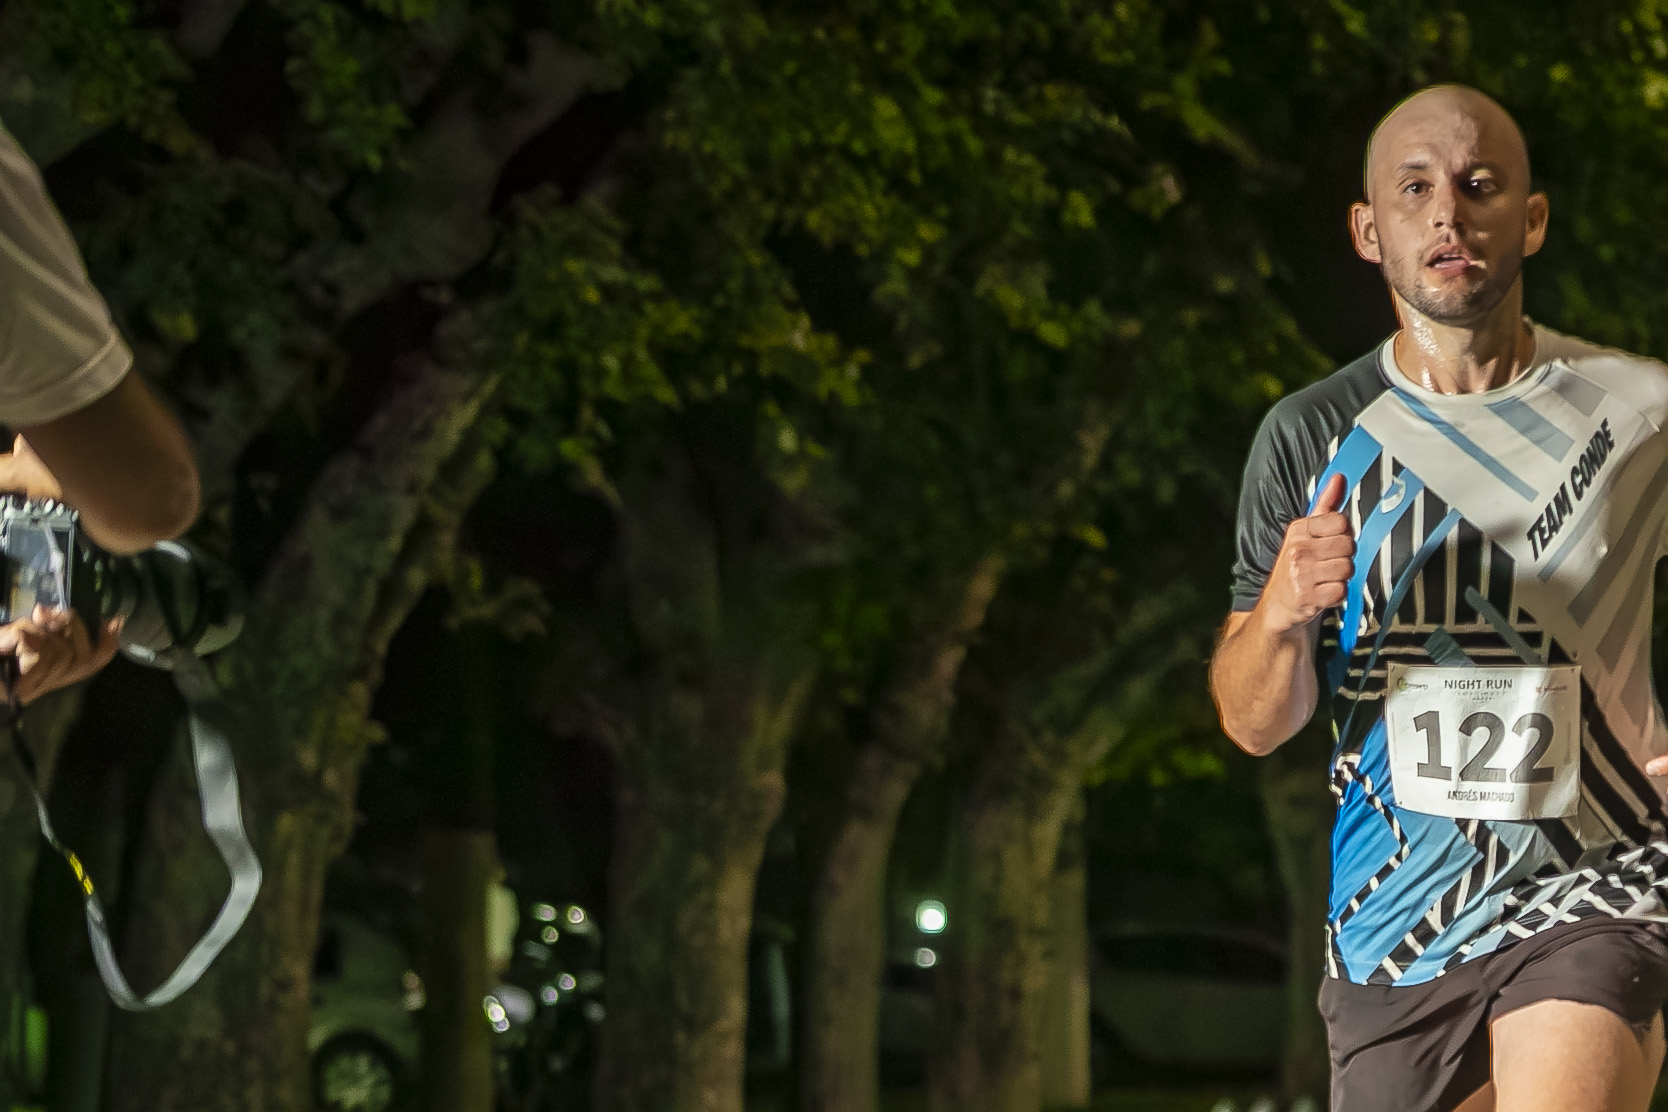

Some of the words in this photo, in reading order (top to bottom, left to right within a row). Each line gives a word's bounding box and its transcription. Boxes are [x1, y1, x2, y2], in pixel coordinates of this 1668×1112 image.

[1526, 481, 1574, 562] TEAM
[1570, 416, 1615, 501] CONDE
[1444, 679, 1482, 690] NIGHT
[1486, 678, 1513, 690] RUN
[1413, 711, 1555, 783] 122
